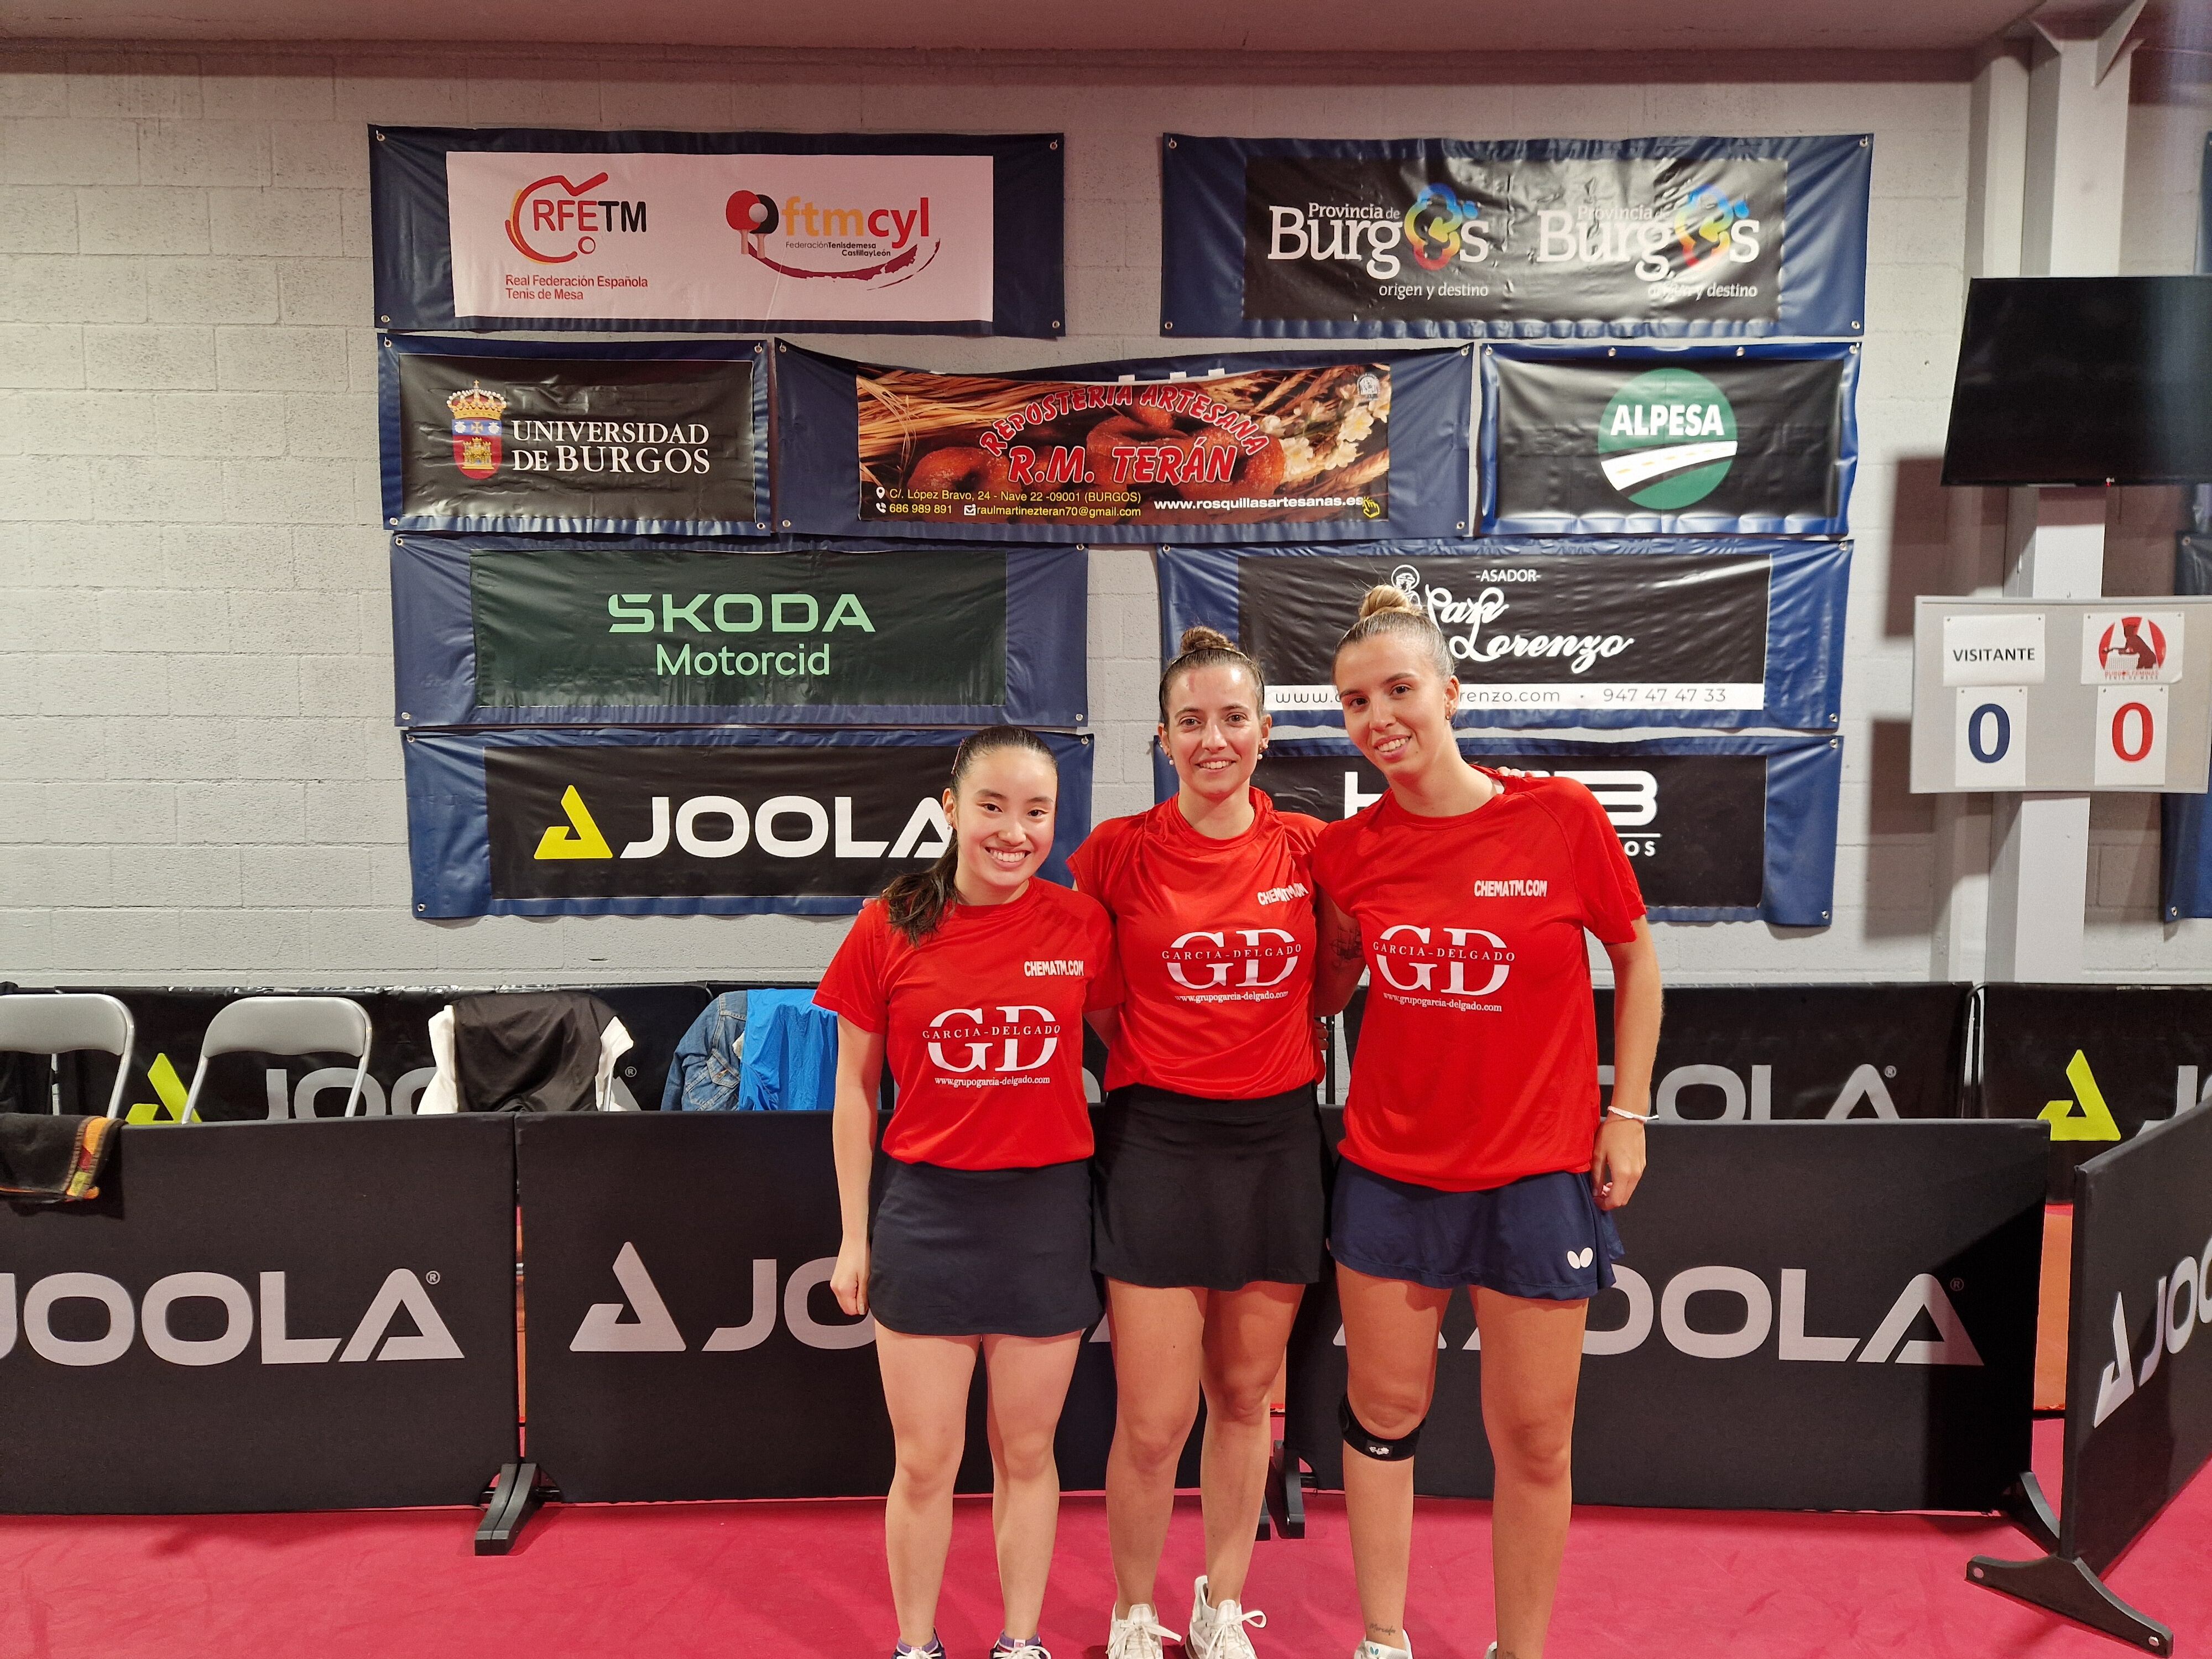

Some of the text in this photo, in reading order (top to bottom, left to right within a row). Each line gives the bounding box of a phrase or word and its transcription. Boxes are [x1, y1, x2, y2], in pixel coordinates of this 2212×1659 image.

[532, 200, 646, 233] RFETM
[1308, 202, 1401, 220] Provincia de
[781, 196, 929, 249] ftmcyl
[505, 274, 648, 289] Real Federación Española
[1707, 281, 1759, 298] destino
[505, 288, 584, 300] Tenis de Mesa
[1379, 283, 1489, 300] origen y destino
[980, 385, 1270, 457] REPOSTERIA ARTESANA
[1610, 404, 1725, 436] ALPESA
[512, 420, 709, 445] UNIVERSIDAD
[512, 446, 711, 474] DE BURGOS
[1008, 436, 1237, 486] R.M. TERÁN
[907, 489, 939, 501] López
[942, 490, 974, 502] Bravo,
[978, 491, 990, 500] 24
[1001, 491, 1027, 501] Nave
[1030, 492, 1043, 502] 22
[1084, 492, 1141, 504] (BURGOS)
[1154, 496, 1363, 512] www.rosquillasartesanas.es
[889, 504, 952, 514] 686 989 891
[977, 505, 1141, 518] raulmartinezteran70@gmail.com
[656, 643, 830, 676] Motorcid
[1953, 648, 2036, 662] VISITANTE
[1604, 688, 1726, 702] 947 47 47 33
[1968, 703, 2011, 764] 0
[2111, 702, 2154, 763] 0
[619, 795, 951, 858] JOOLA
[1474, 879, 1547, 897] CHEMATM.COM
[1162, 944, 1302, 960] GARCIA-DELGADO
[1373, 941, 1516, 962] GARCIA-DELGADO
[1024, 959, 1084, 977] CHEMATM.COM
[1175, 990, 1289, 1004] www.grupogarcia-delgado.com
[1383, 992, 1503, 1012] www.grupogarcia-delgado.com
[922, 1025, 1061, 1039] GARCIA-DELGADO
[935, 1075, 1050, 1088] www.grupogarcia-delgado.com
